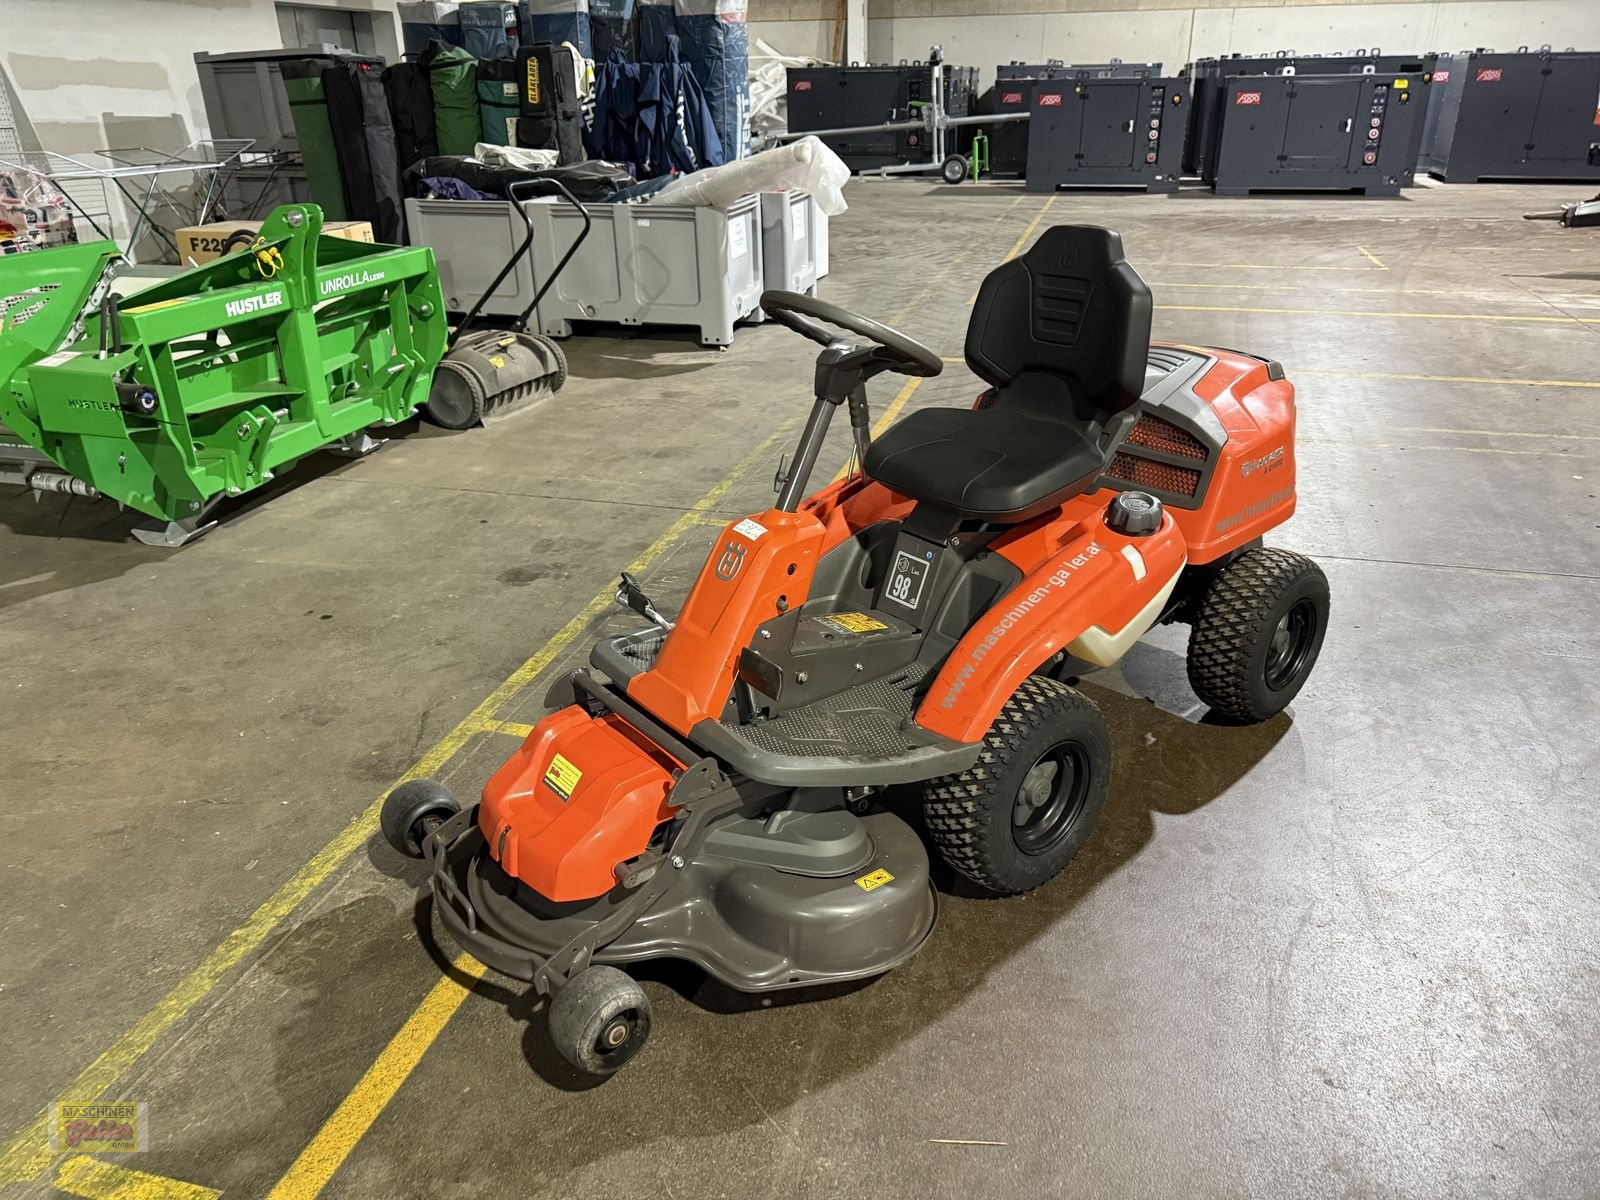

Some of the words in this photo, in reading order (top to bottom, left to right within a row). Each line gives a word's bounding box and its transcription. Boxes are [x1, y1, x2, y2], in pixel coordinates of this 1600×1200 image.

[320, 270, 369, 294] UNROLLA
[225, 291, 282, 317] HUSTLER
[892, 573, 911, 600] 98
